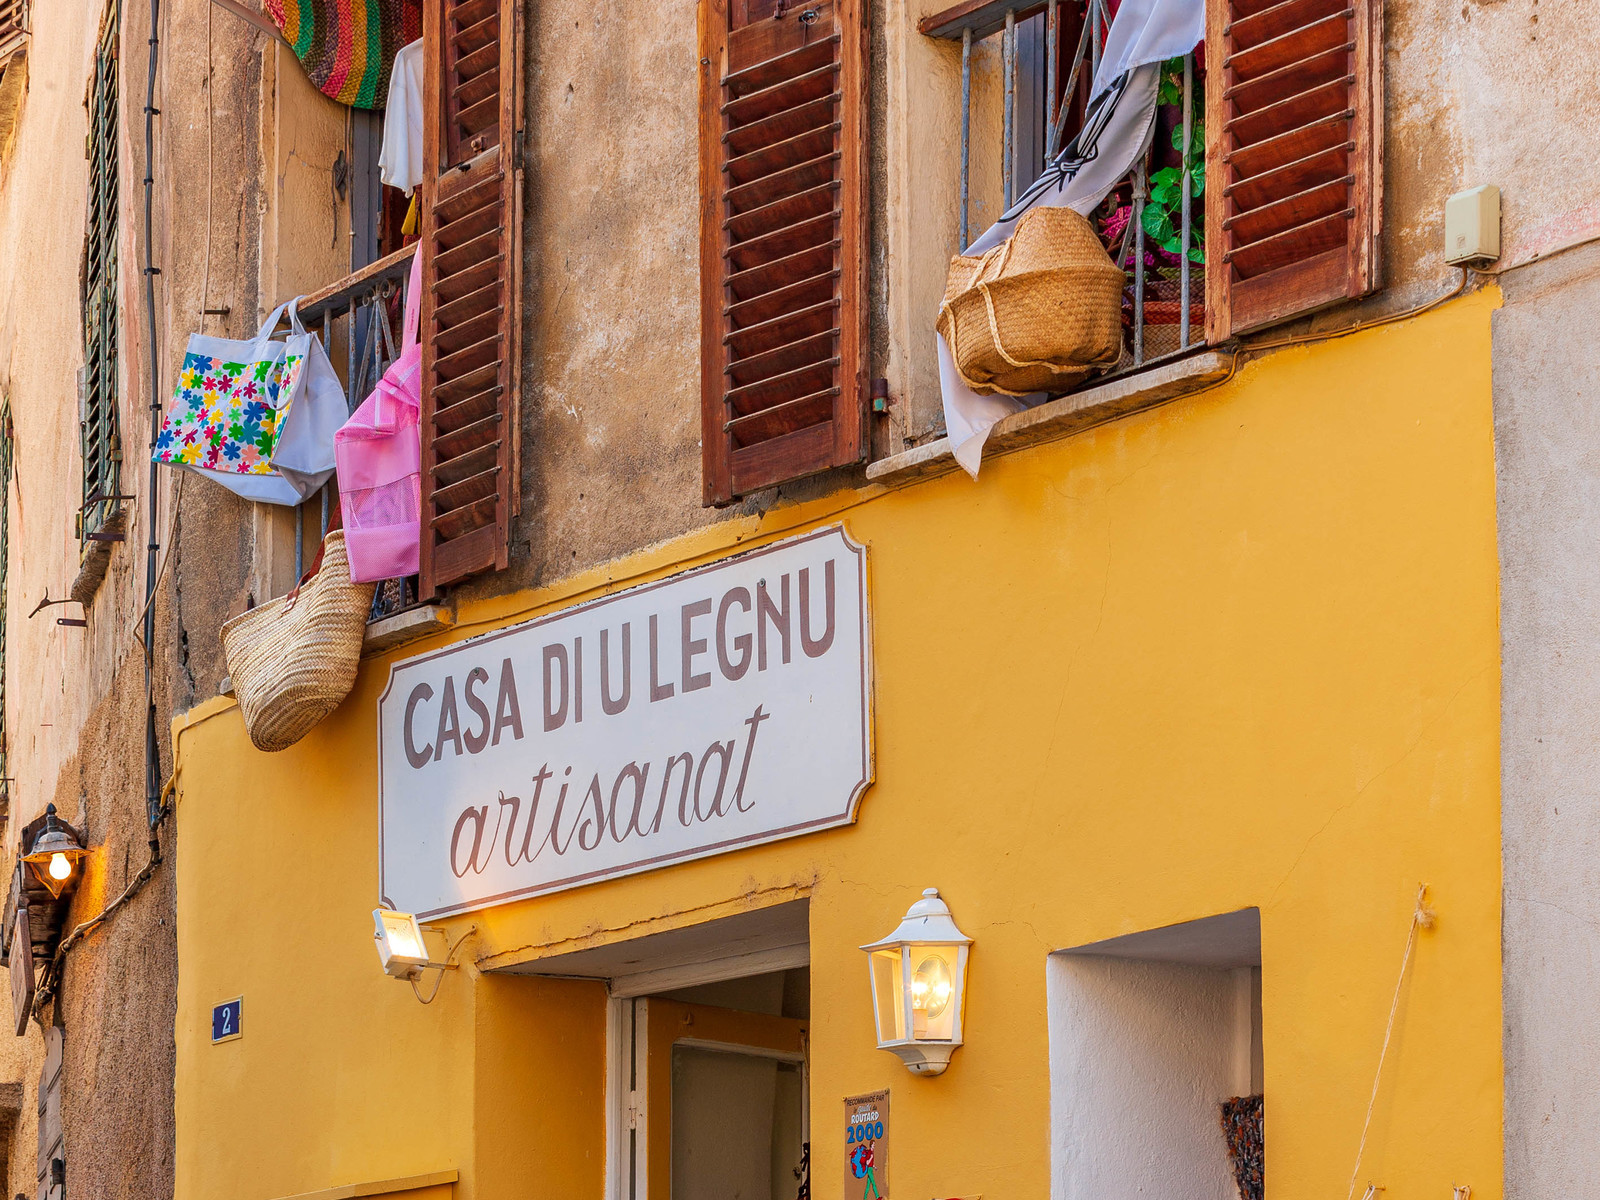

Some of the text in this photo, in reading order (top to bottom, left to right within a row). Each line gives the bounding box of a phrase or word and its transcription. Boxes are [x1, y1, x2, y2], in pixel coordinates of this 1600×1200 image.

[403, 558, 836, 769] CASA DI U LEGNU
[450, 703, 770, 879] artisanat
[222, 1007, 231, 1035] 2
[851, 1111, 879, 1124] ROUTARD
[847, 1121, 884, 1144] 2000
